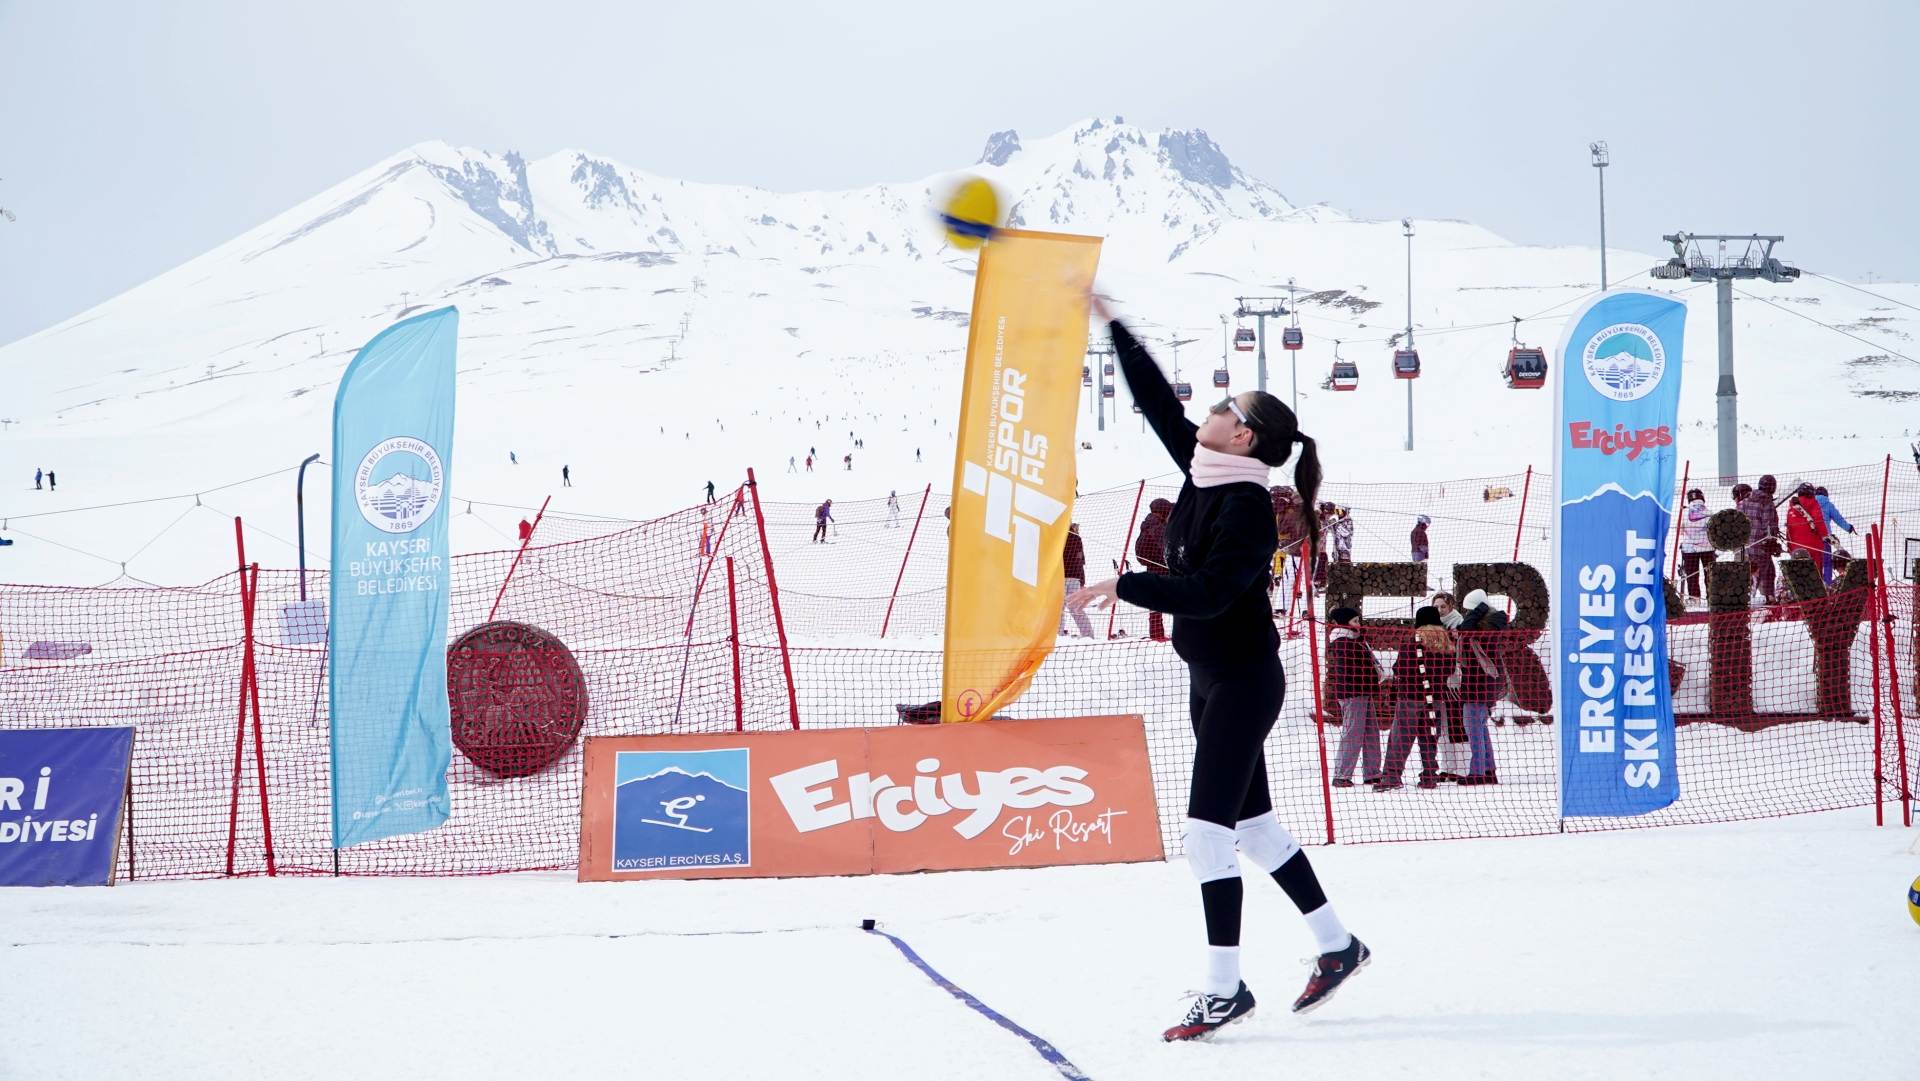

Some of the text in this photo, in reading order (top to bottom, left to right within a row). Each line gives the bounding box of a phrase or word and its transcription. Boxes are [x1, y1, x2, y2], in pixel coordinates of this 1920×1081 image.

[994, 367, 1027, 476] SPOR
[1568, 421, 1673, 462] Erciyes
[367, 537, 430, 557] KAYSERİ
[389, 520, 413, 530] 1869
[1569, 564, 1616, 753] ERCİYES
[1624, 530, 1660, 789] SKI RESORT
[769, 757, 1095, 840] Erciyes
[0, 813, 98, 843] DİYESİ
[1002, 808, 1128, 856] Ski Resort
[617, 857, 666, 868] KAYSERİ
[669, 854, 720, 866] ERCİYES
